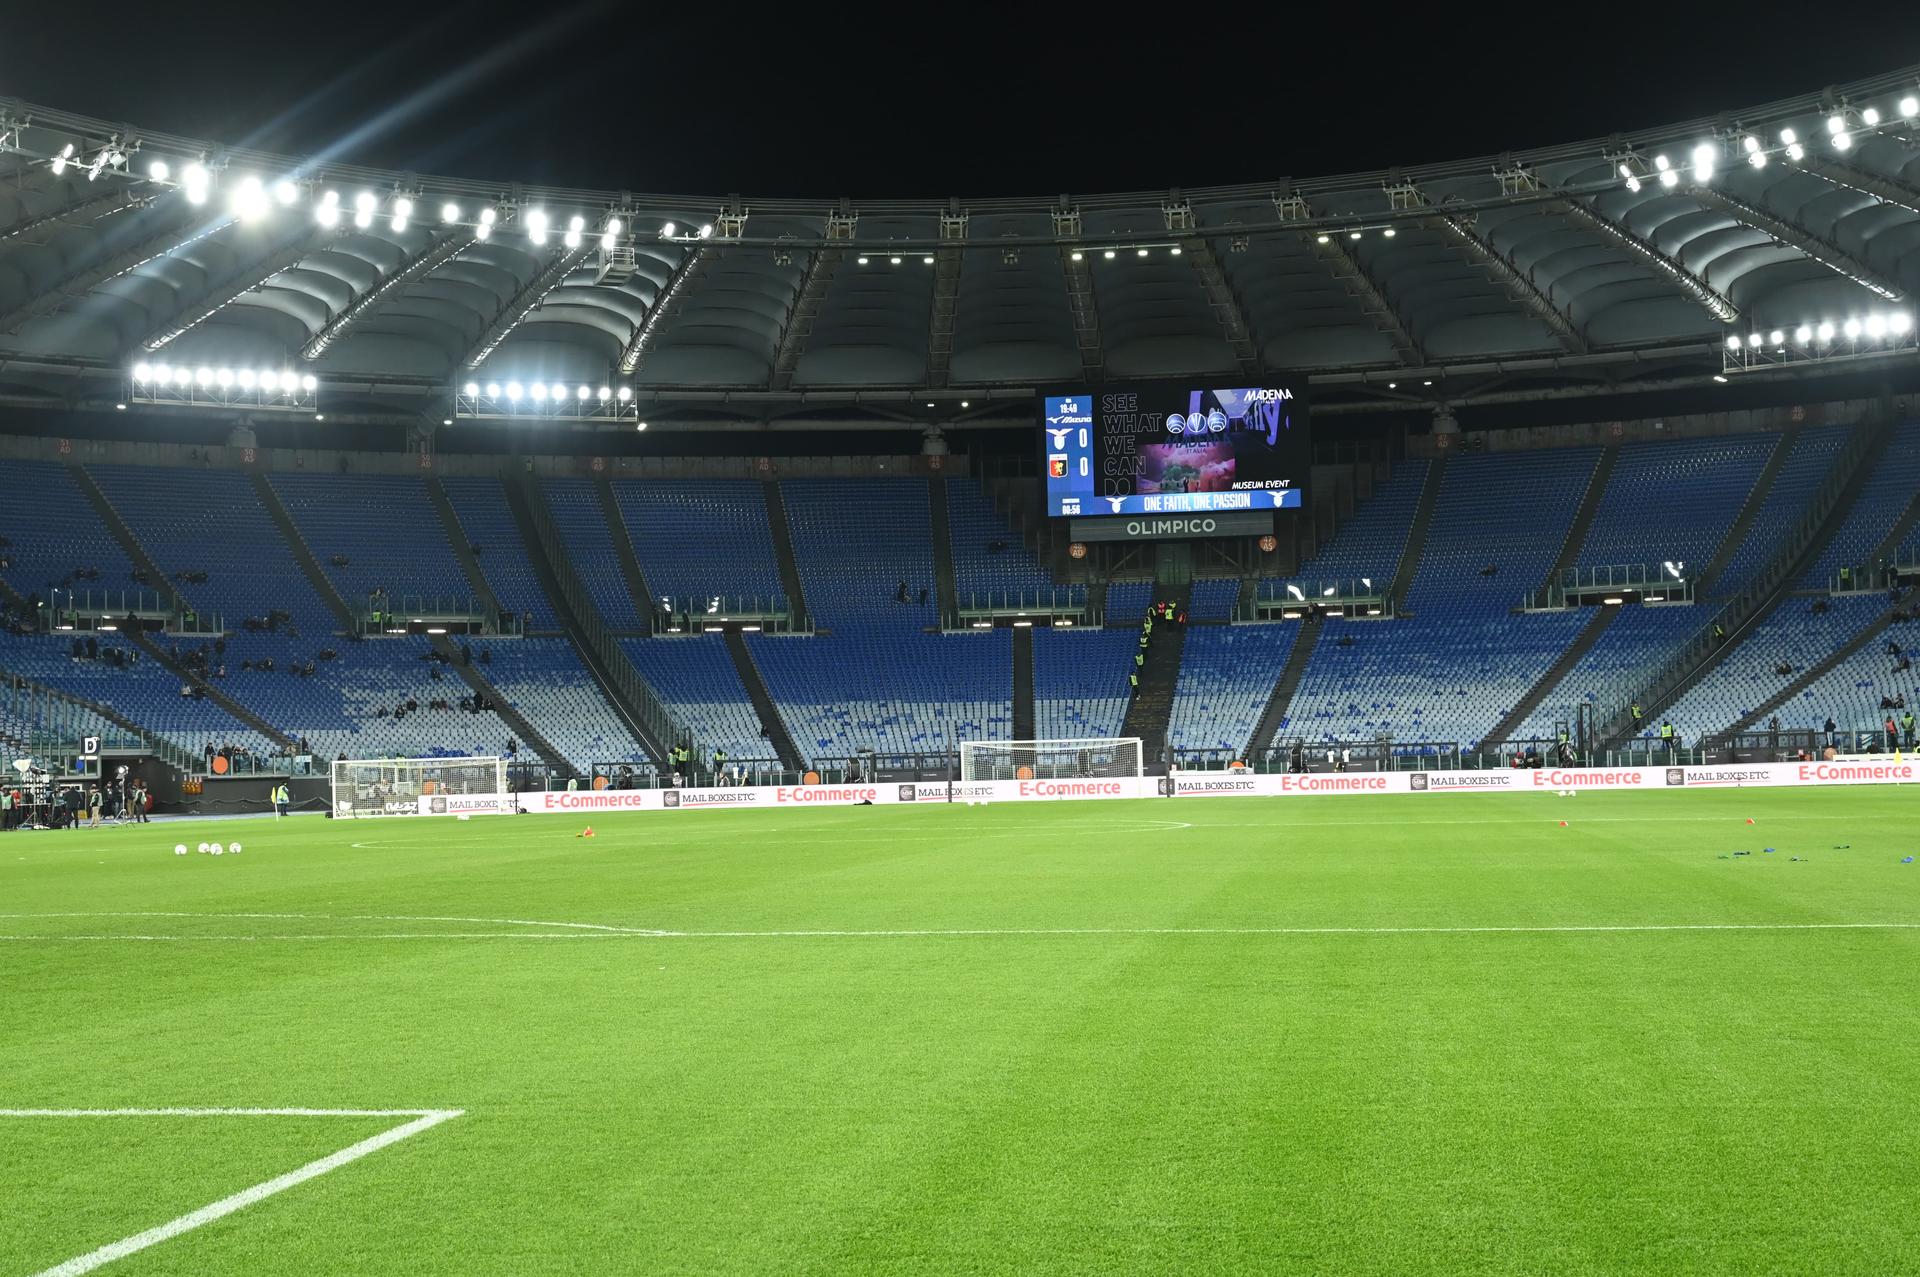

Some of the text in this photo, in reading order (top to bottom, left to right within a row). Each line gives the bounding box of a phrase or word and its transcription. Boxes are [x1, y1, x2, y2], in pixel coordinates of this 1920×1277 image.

[1102, 393, 1138, 412] SEE
[1103, 413, 1162, 433] WHAT
[1079, 428, 1088, 448] 0
[1103, 435, 1136, 454] WE
[1080, 456, 1088, 476] 0
[1104, 456, 1147, 475] CAN
[1104, 477, 1130, 497] DO
[1231, 479, 1290, 490] MUSEUM EVENT
[1144, 496, 1162, 511] ONE
[1194, 494, 1211, 509] ONE
[1213, 493, 1250, 508] PASSION
[1127, 519, 1216, 535] OLIMPICO
[1534, 771, 1641, 786] E-Commerce
[1687, 772, 1714, 781] MAIL
[1716, 772, 1748, 781] BOXES
[1799, 765, 1912, 780] E-Commerce
[1020, 781, 1120, 796] E-Commerce
[1178, 782, 1203, 791] MAIL
[1205, 782, 1235, 790] BOXES
[1282, 776, 1386, 791] E-Commerce
[1431, 777, 1457, 786] MAIL
[1459, 776, 1489, 785] BOXES
[683, 794, 707, 803] MAIL
[708, 793, 737, 802] BOXES
[777, 787, 876, 802] E-Commerce
[919, 788, 943, 797] MAIL
[449, 801, 473, 809] MAIL
[474, 800, 500, 808] BOXE
[545, 793, 640, 808] E-Commerce
